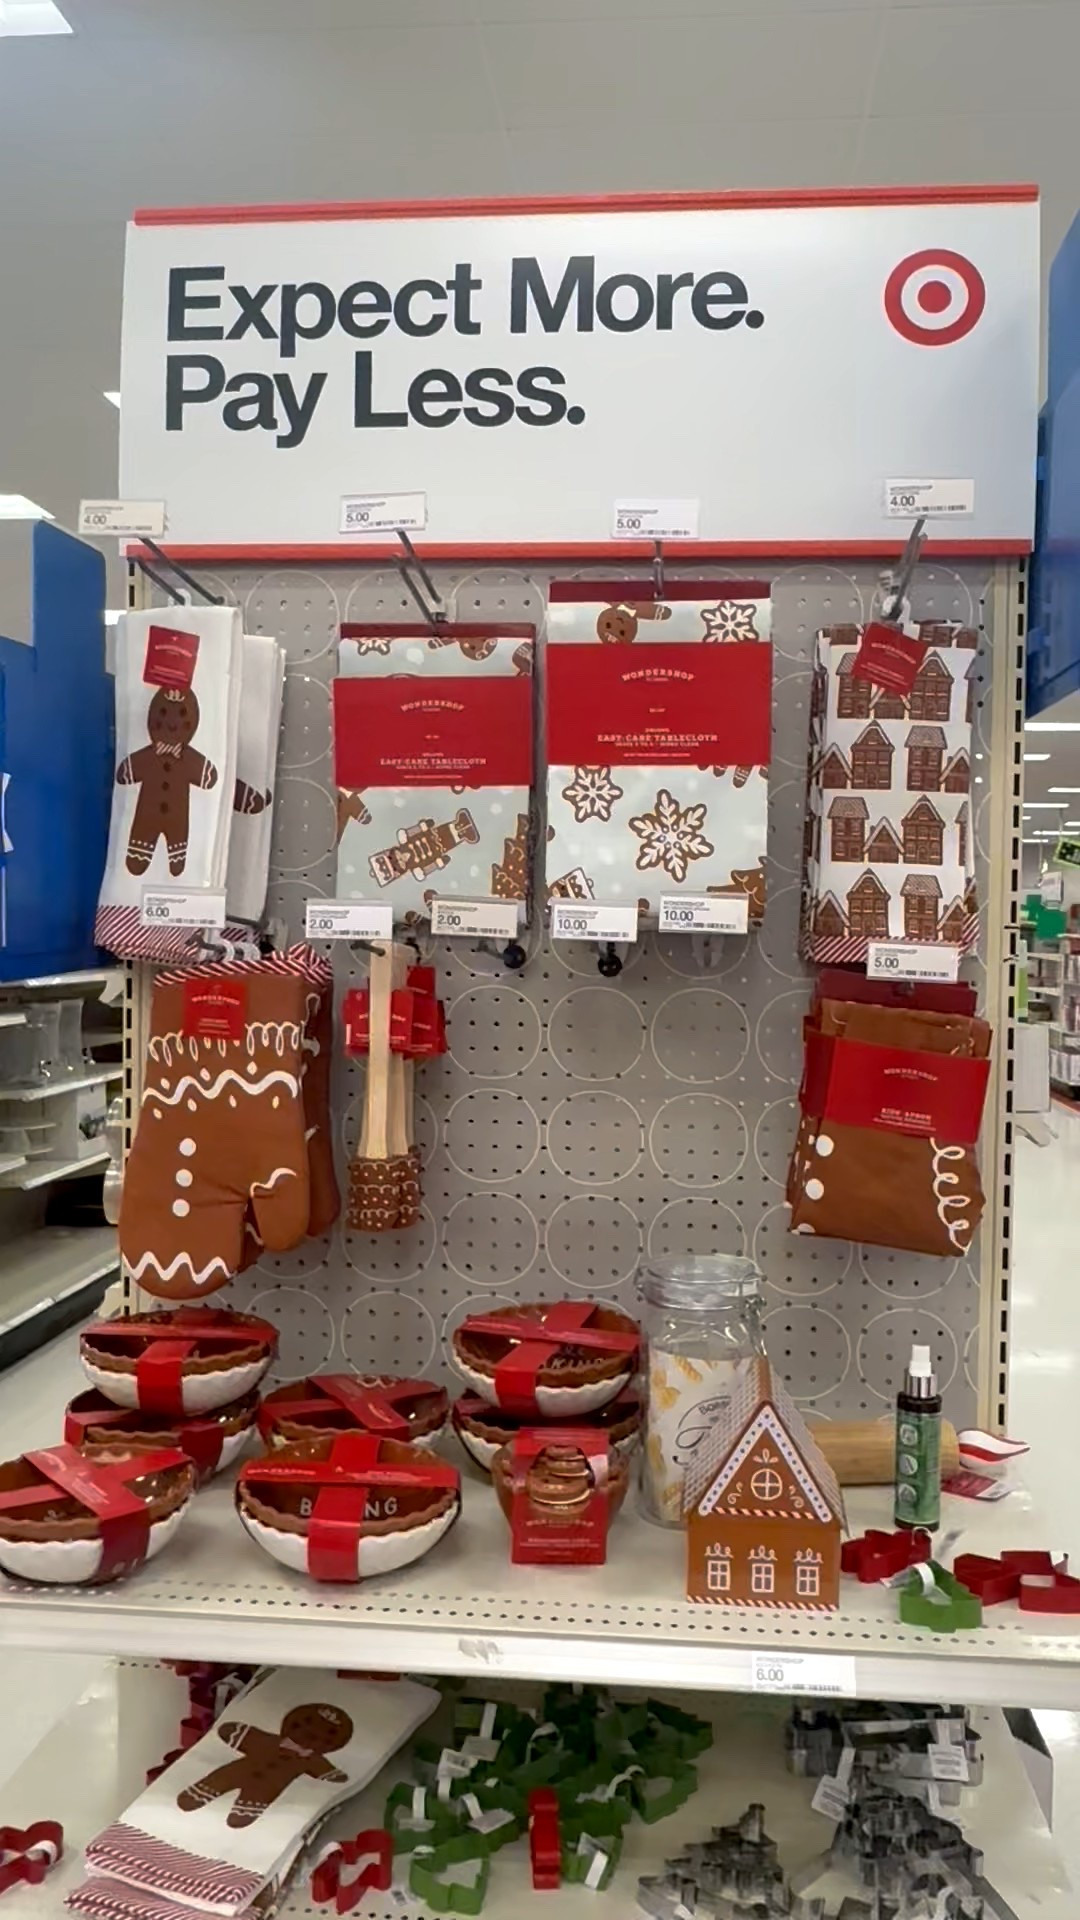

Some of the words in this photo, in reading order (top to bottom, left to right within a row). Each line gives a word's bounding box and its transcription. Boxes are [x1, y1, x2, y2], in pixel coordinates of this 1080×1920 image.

[167, 262, 483, 358] Expect
[509, 255, 766, 334] More.
[165, 353, 328, 449] Pay
[353, 350, 587, 429] Less.
[890, 495, 915, 507] 4.00
[83, 514, 108, 525] 4.00
[346, 511, 370, 523] 5.00
[616, 518, 642, 530] 5.00
[621, 668, 695, 682] WONDERSHOP
[145, 905, 170, 917] 6.00
[663, 910, 694, 922] 10.00
[309, 919, 334, 930] 2.00
[437, 914, 462, 926] 2.00
[558, 918, 588, 930] 10.00
[874, 956, 900, 969] 5.00
[756, 1668, 784, 1682] 6.00
